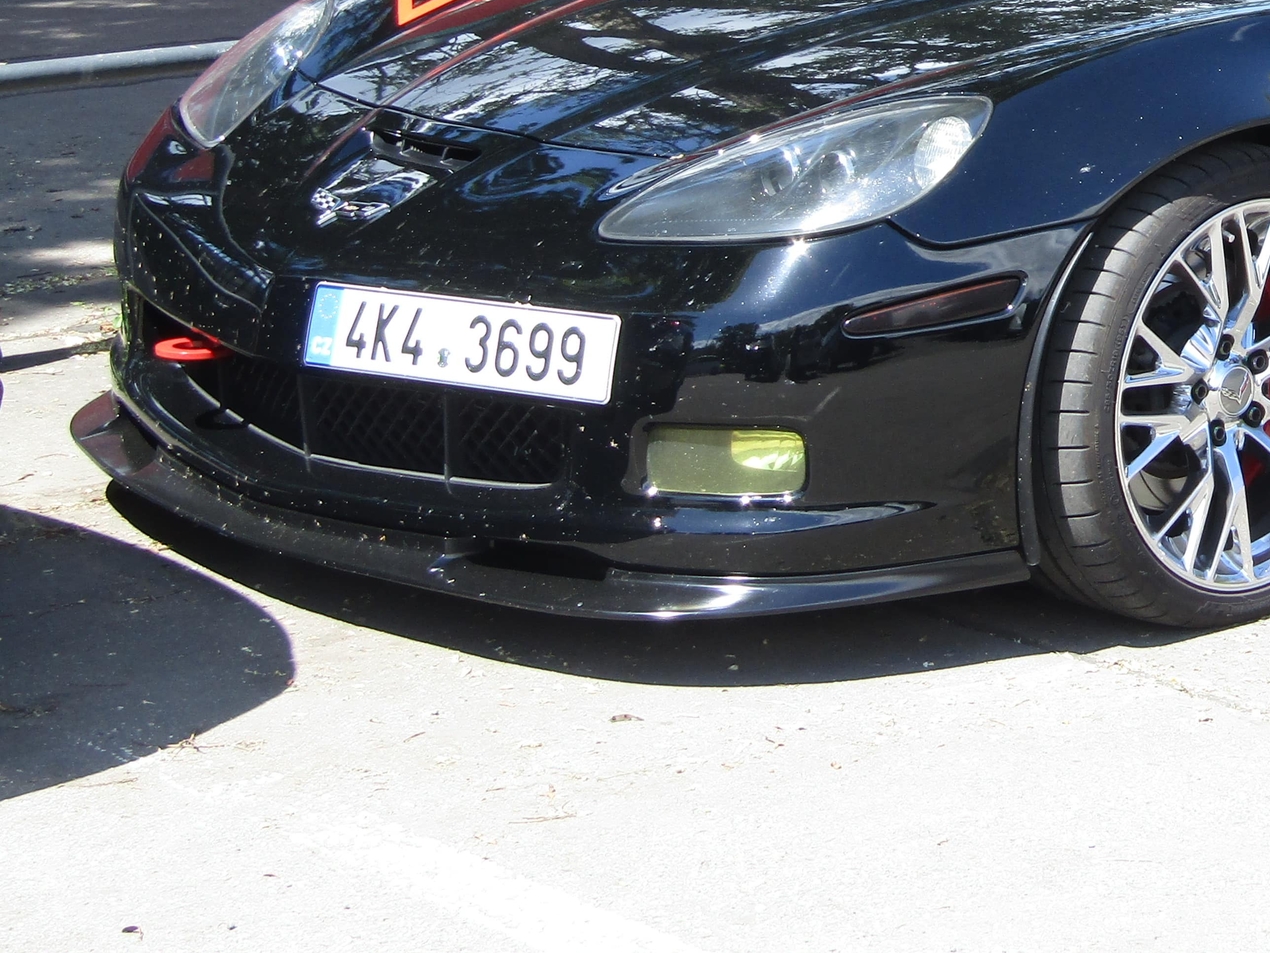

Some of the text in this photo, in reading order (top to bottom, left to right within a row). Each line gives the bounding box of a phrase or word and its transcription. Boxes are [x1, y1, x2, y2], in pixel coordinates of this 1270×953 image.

[309, 335, 333, 356] CZ
[345, 300, 587, 385] 4K4 3699
